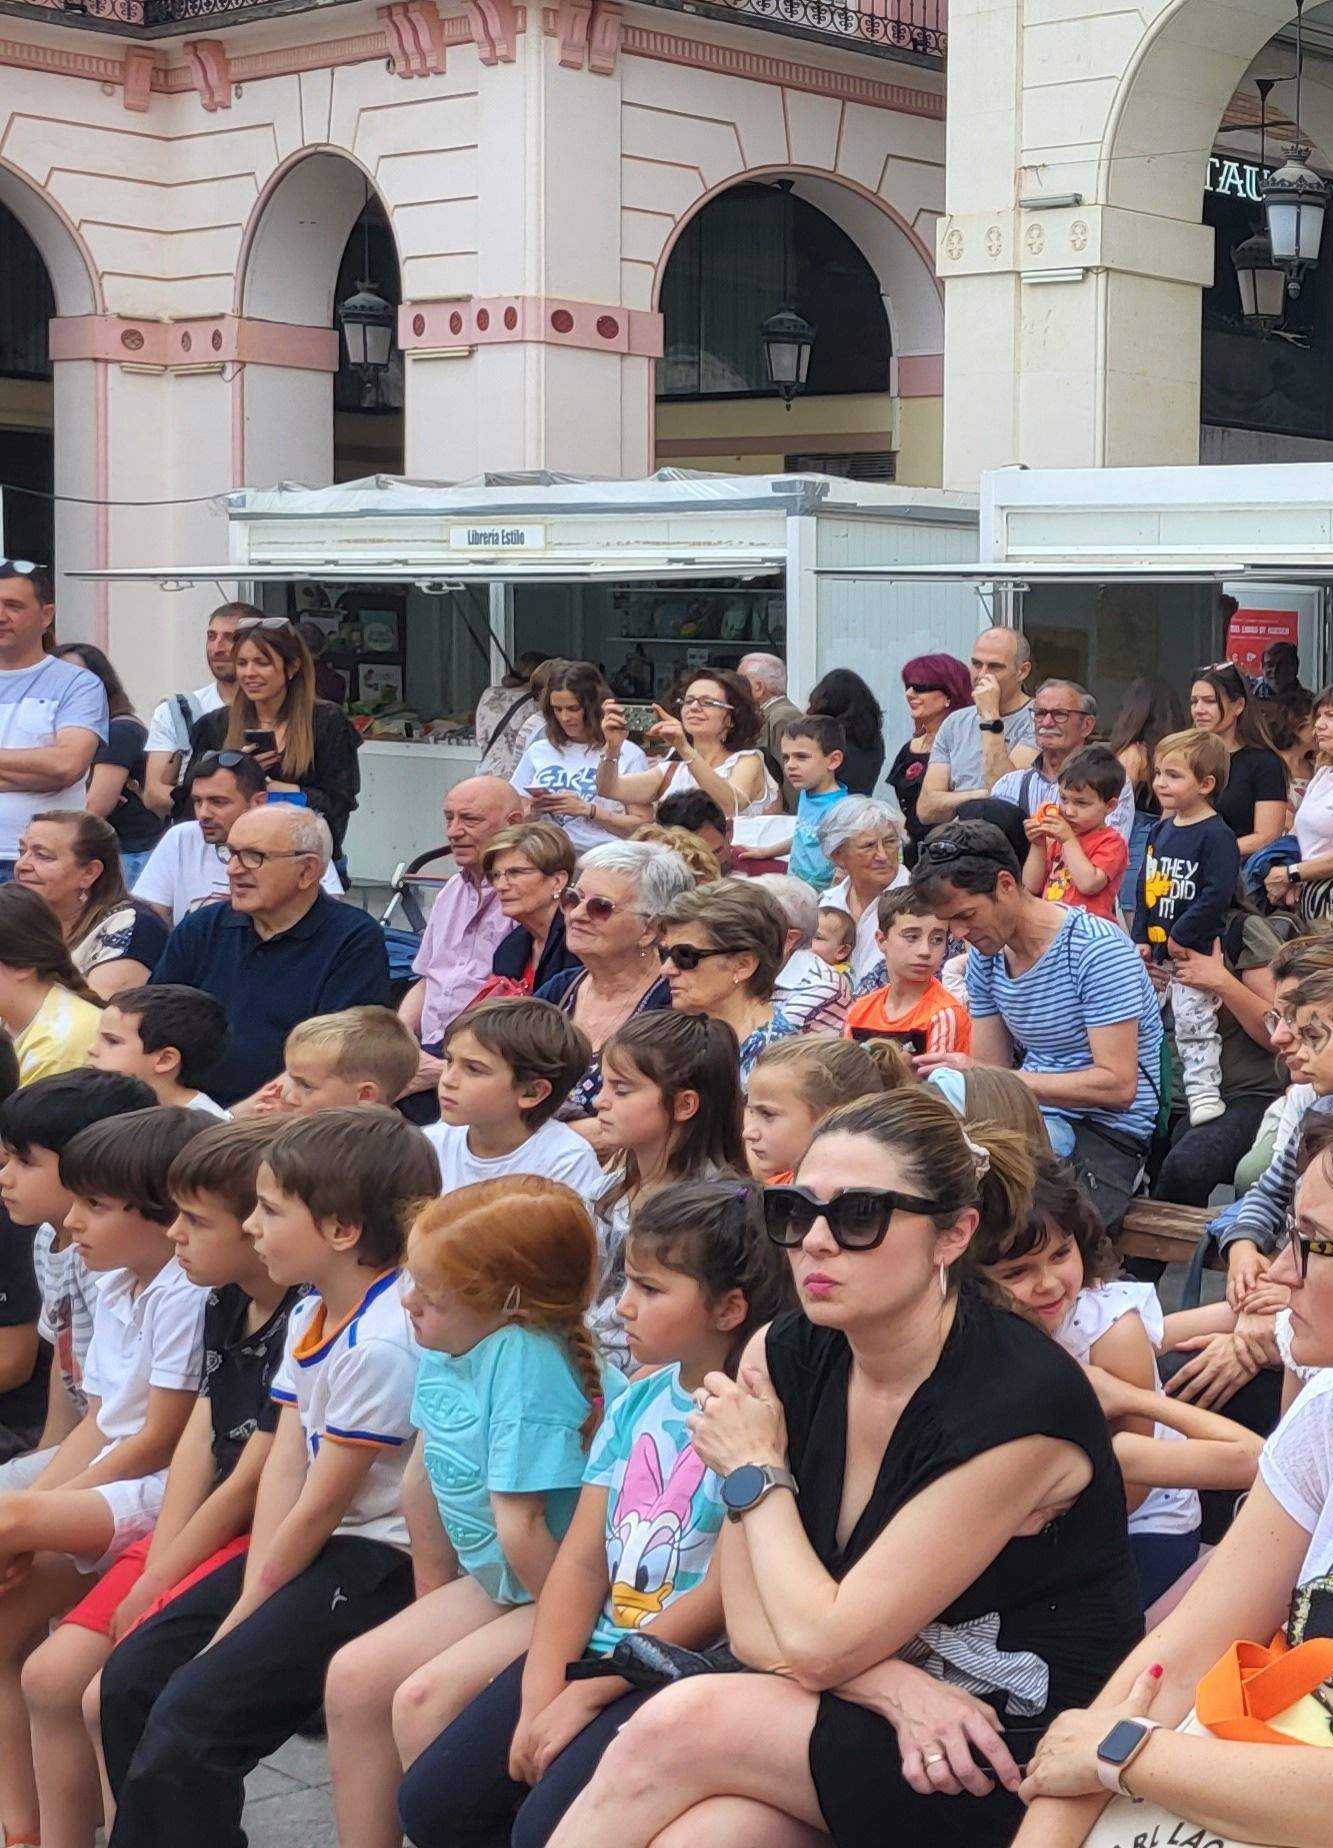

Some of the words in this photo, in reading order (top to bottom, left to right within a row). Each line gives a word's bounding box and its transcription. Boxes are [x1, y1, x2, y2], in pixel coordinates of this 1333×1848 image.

[467, 528, 499, 545] Librería
[501, 528, 525, 545] Estilo
[1160, 856, 1199, 880] THEY
[1169, 879, 1196, 900] DID
[1158, 897, 1175, 919] IT!
